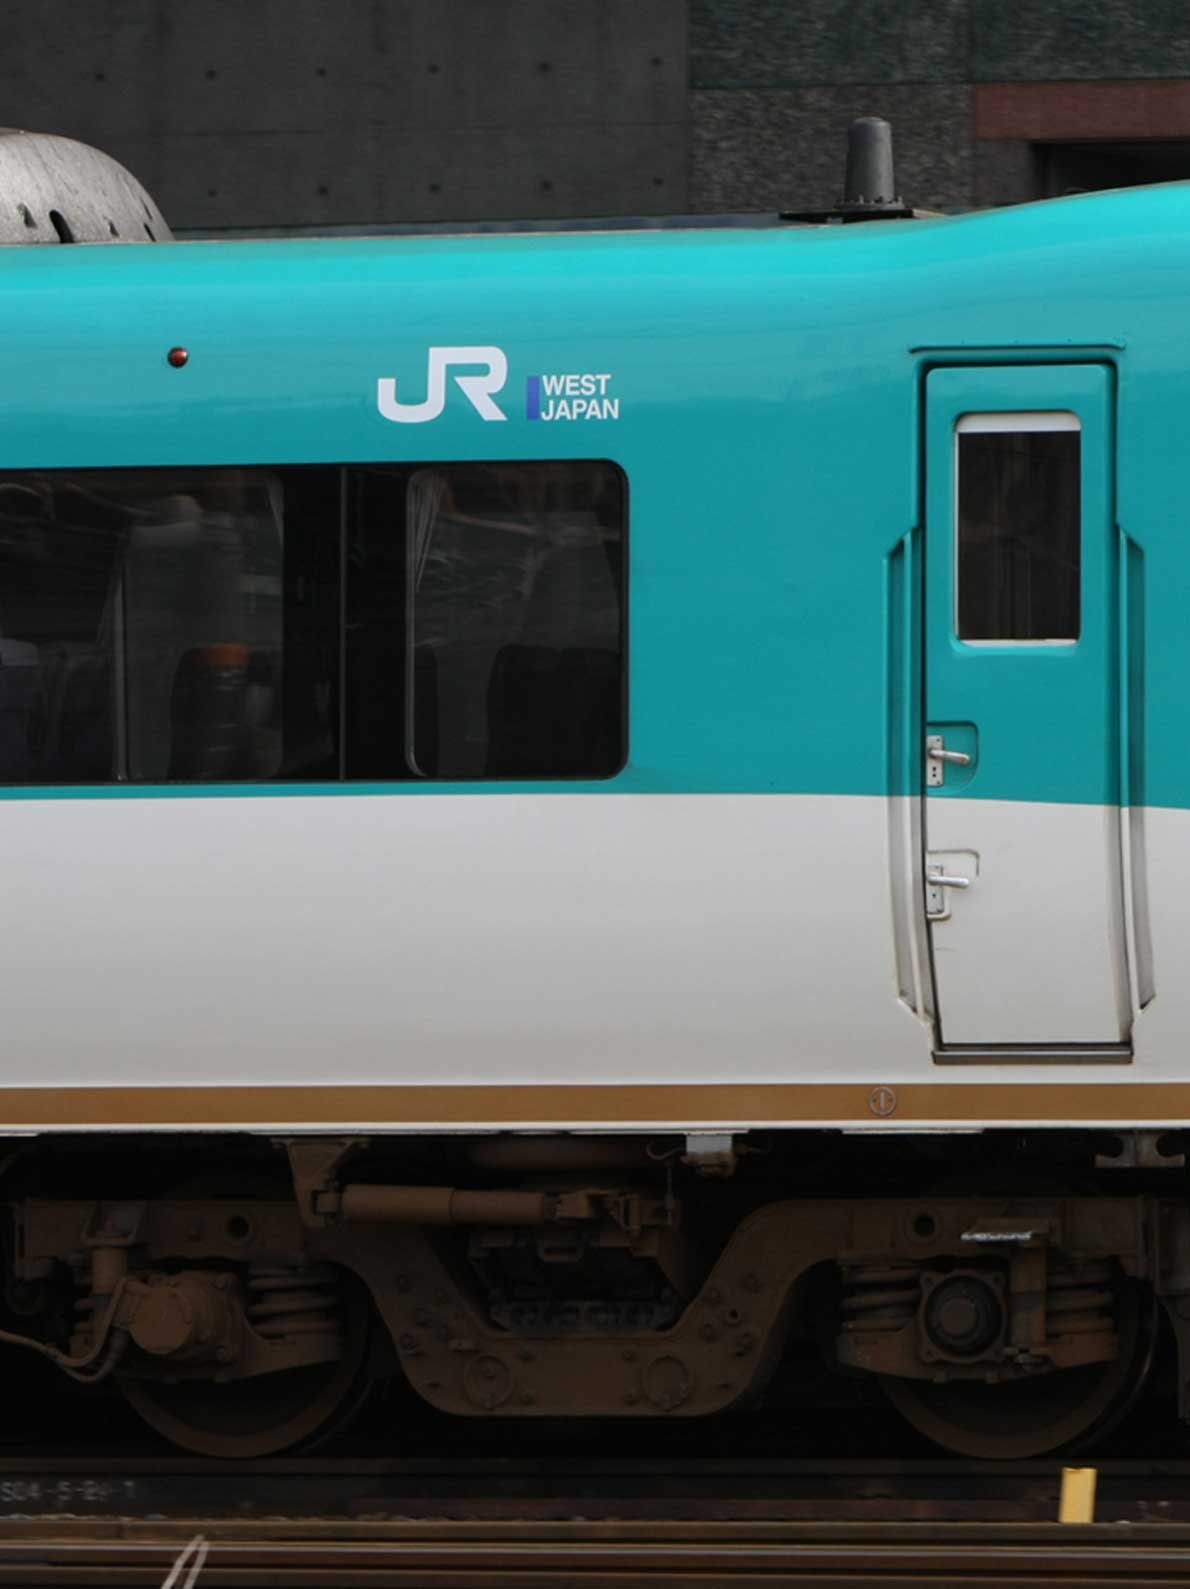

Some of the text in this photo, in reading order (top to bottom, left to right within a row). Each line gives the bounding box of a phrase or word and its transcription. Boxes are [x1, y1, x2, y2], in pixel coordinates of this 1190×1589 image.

[377, 346, 508, 423] JR
[542, 374, 611, 396] WEST
[541, 399, 619, 421] JAPAN
